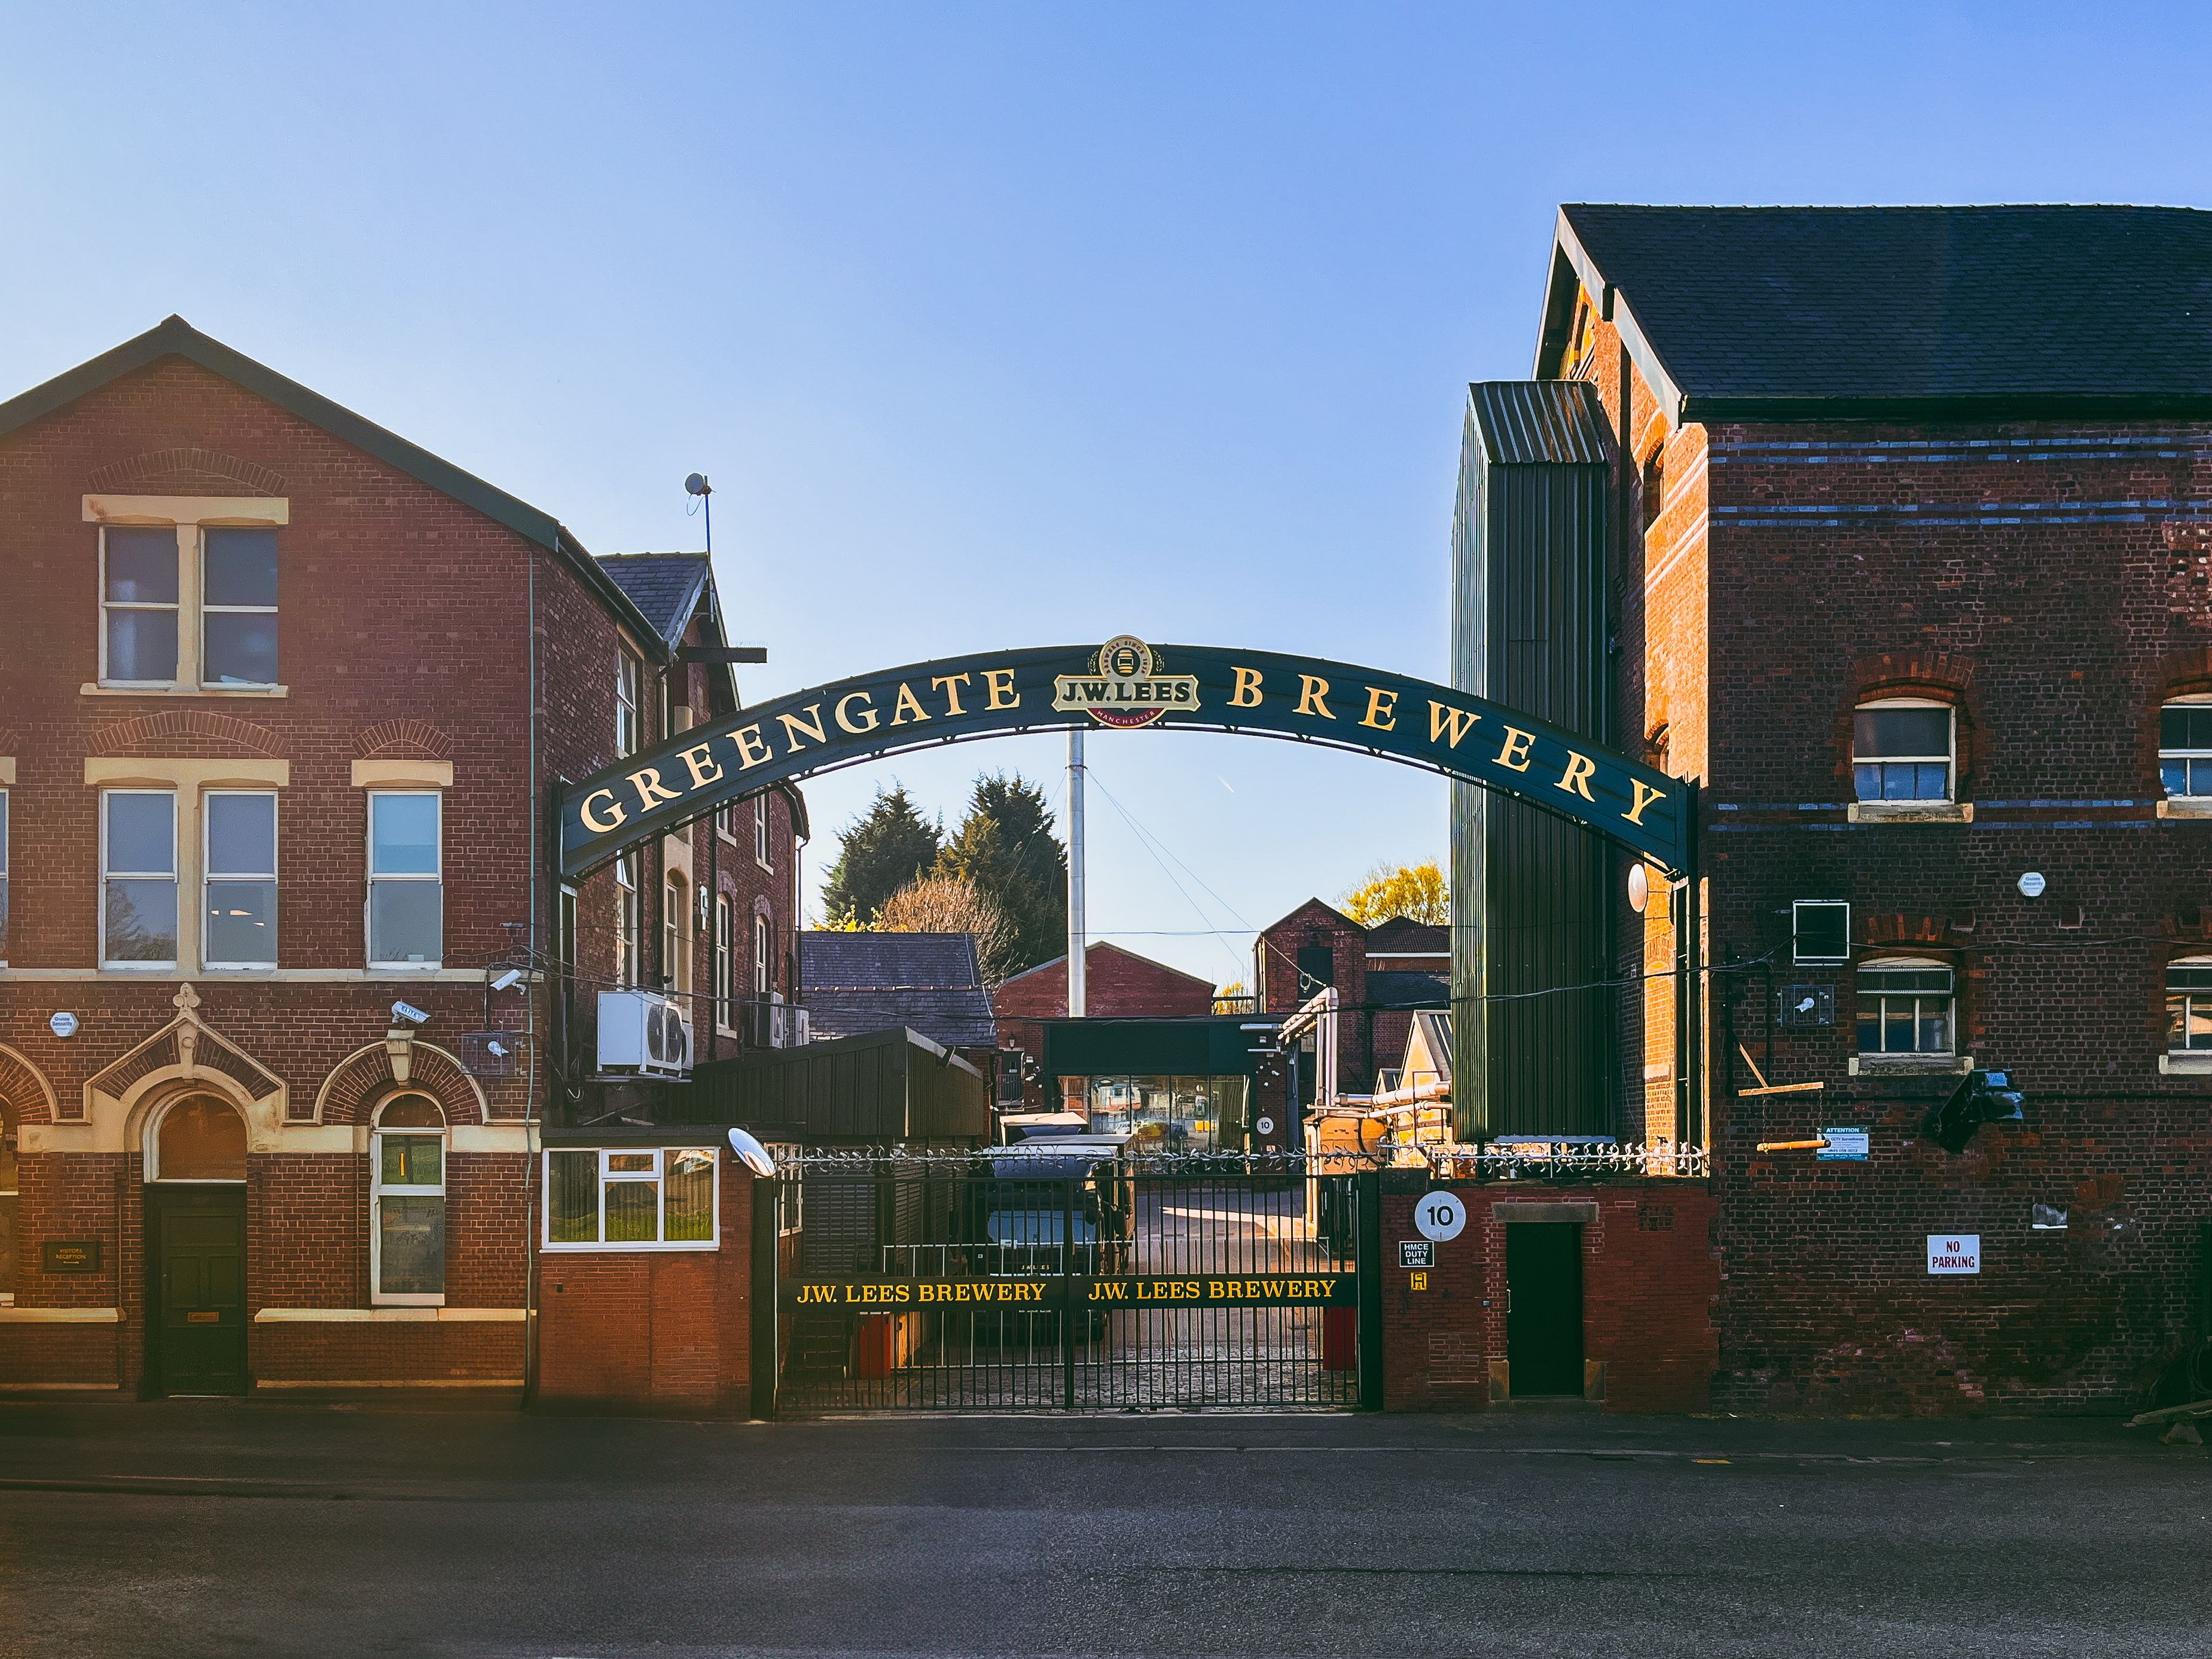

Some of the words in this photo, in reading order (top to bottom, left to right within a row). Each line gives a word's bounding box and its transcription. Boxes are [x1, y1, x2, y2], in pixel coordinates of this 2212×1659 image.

[1097, 710, 1155, 725] MANCHESTER
[580, 668, 1021, 833] GREENGATE
[1226, 666, 1667, 827] BREWERY
[1261, 1121, 1270, 1129] 10
[1427, 1206, 1454, 1226] 10
[1946, 1241, 1960, 1253] NO
[1932, 1256, 1975, 1269] PARKING
[1413, 1273, 1424, 1288] H
[797, 1285, 838, 1303] J.W.
[845, 1285, 910, 1303] LEES
[918, 1283, 1046, 1301] BREWERY
[1088, 1282, 1128, 1300] J.W.
[1137, 1281, 1200, 1299] LEES
[1208, 1280, 1335, 1298] BREWERY
